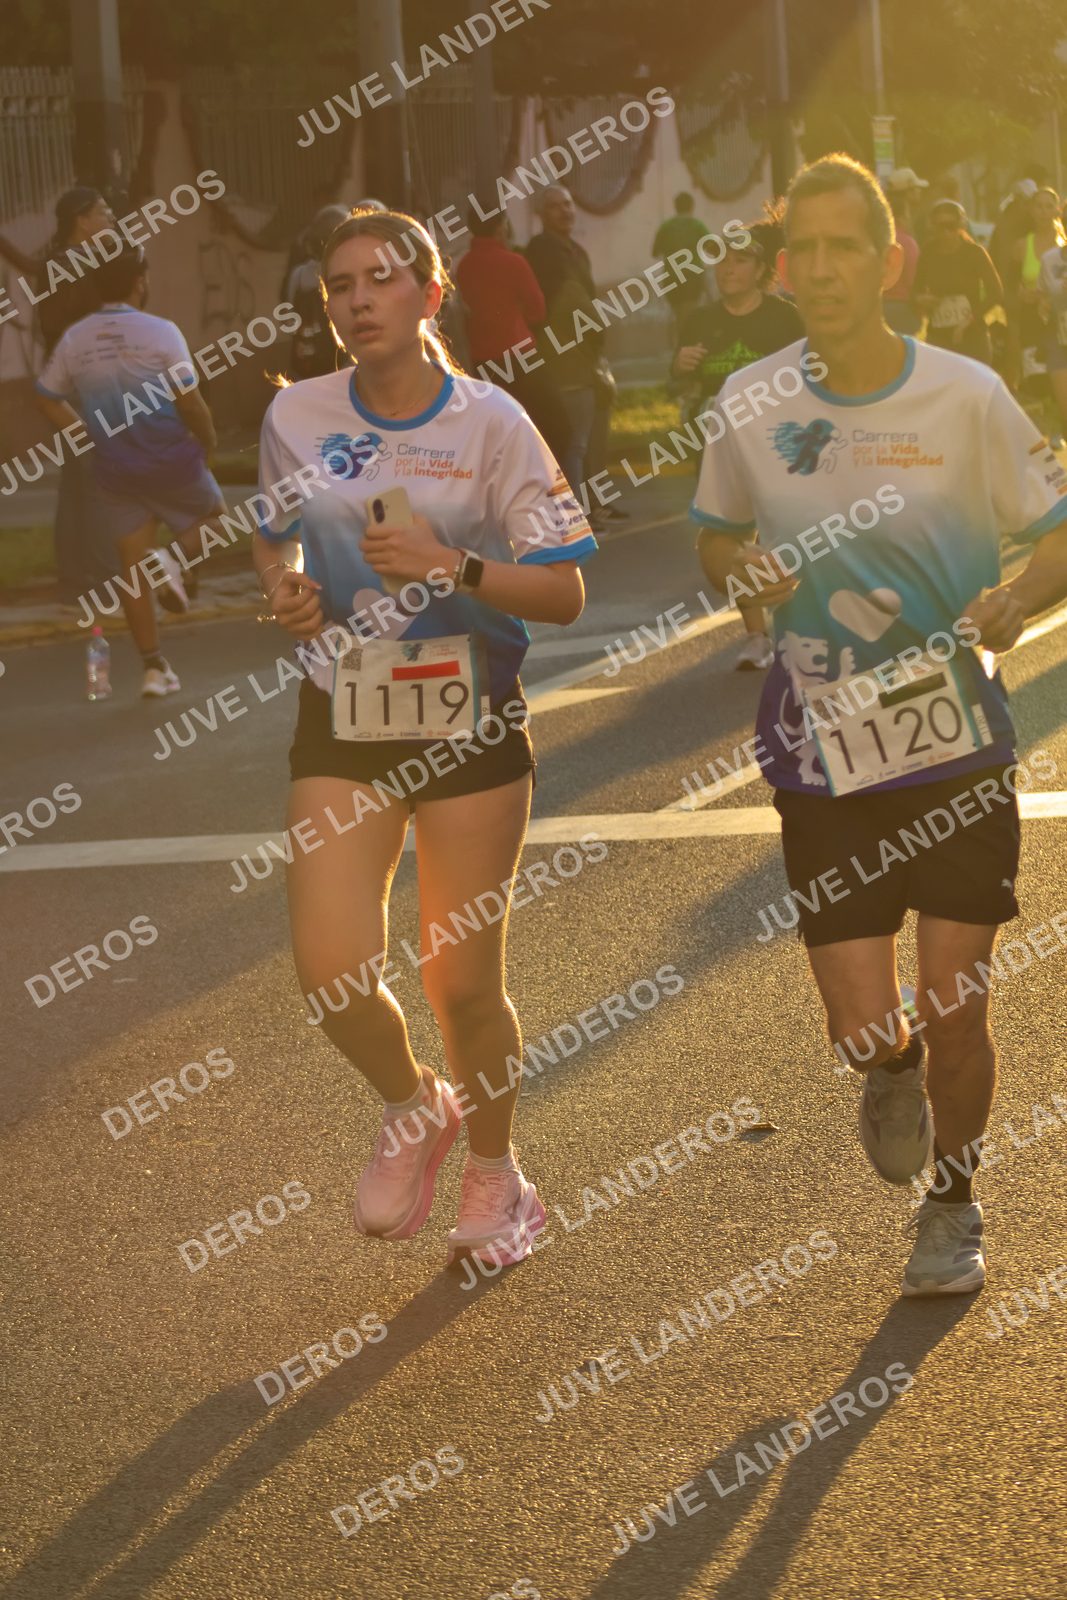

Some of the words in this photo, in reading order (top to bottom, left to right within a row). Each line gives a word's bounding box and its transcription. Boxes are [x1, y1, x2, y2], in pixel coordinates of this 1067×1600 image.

[852, 429, 918, 443] Carrera
[397, 443, 456, 459] Carrera
[890, 444, 919, 454] Vida
[877, 454, 944, 469] Integridad
[414, 467, 473, 480] Integridad
[344, 681, 469, 726] 1119
[829, 696, 962, 774] 1120
